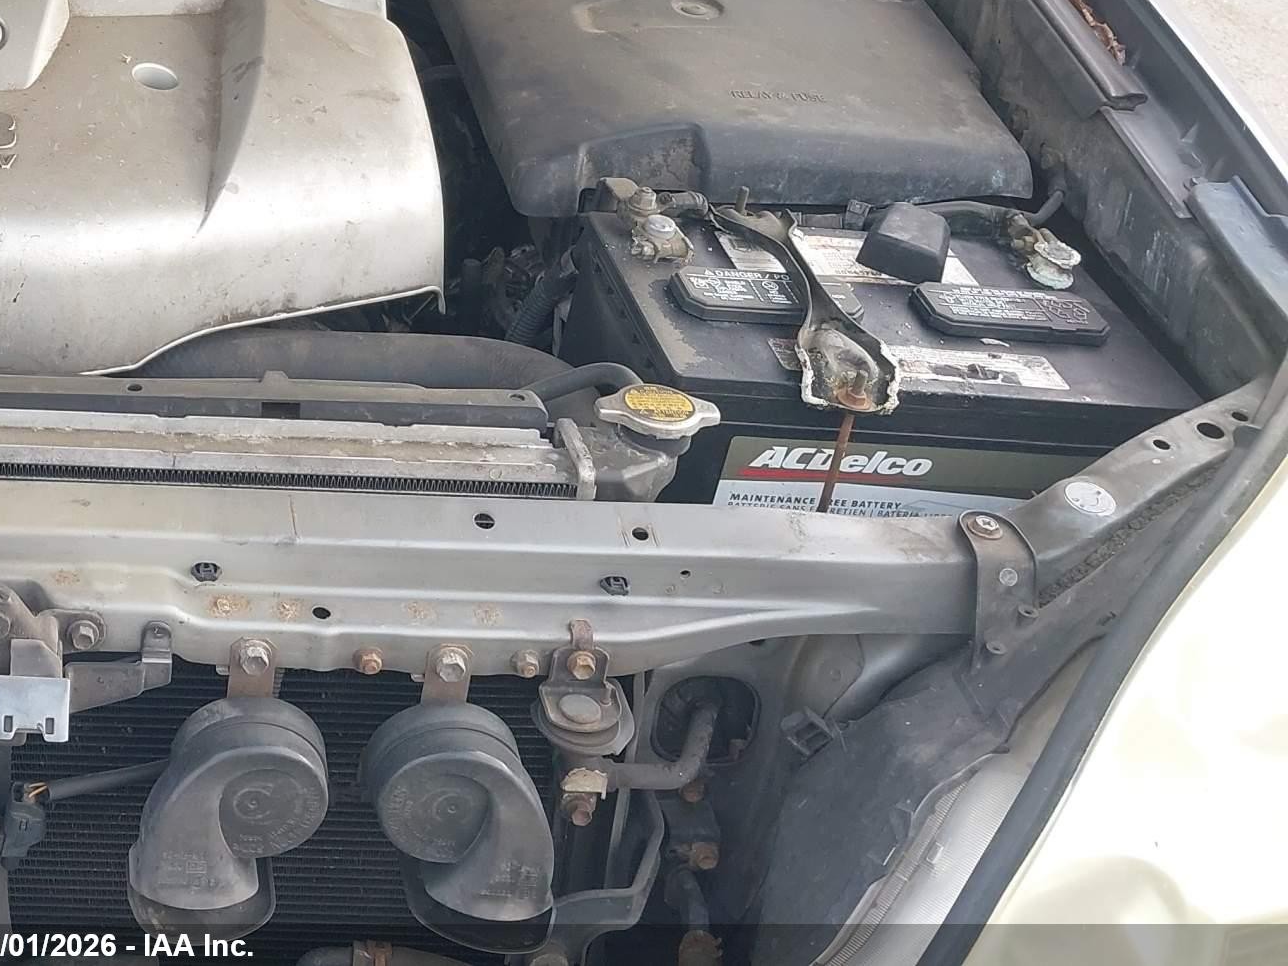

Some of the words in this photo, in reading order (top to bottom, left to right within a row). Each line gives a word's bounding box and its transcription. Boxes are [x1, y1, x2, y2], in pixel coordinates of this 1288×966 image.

[715, 269, 761, 280] DANGER
[748, 445, 933, 477] ACDelco
[729, 492, 817, 505] MAINTENANCE
[851, 499, 902, 511] BATTERY
